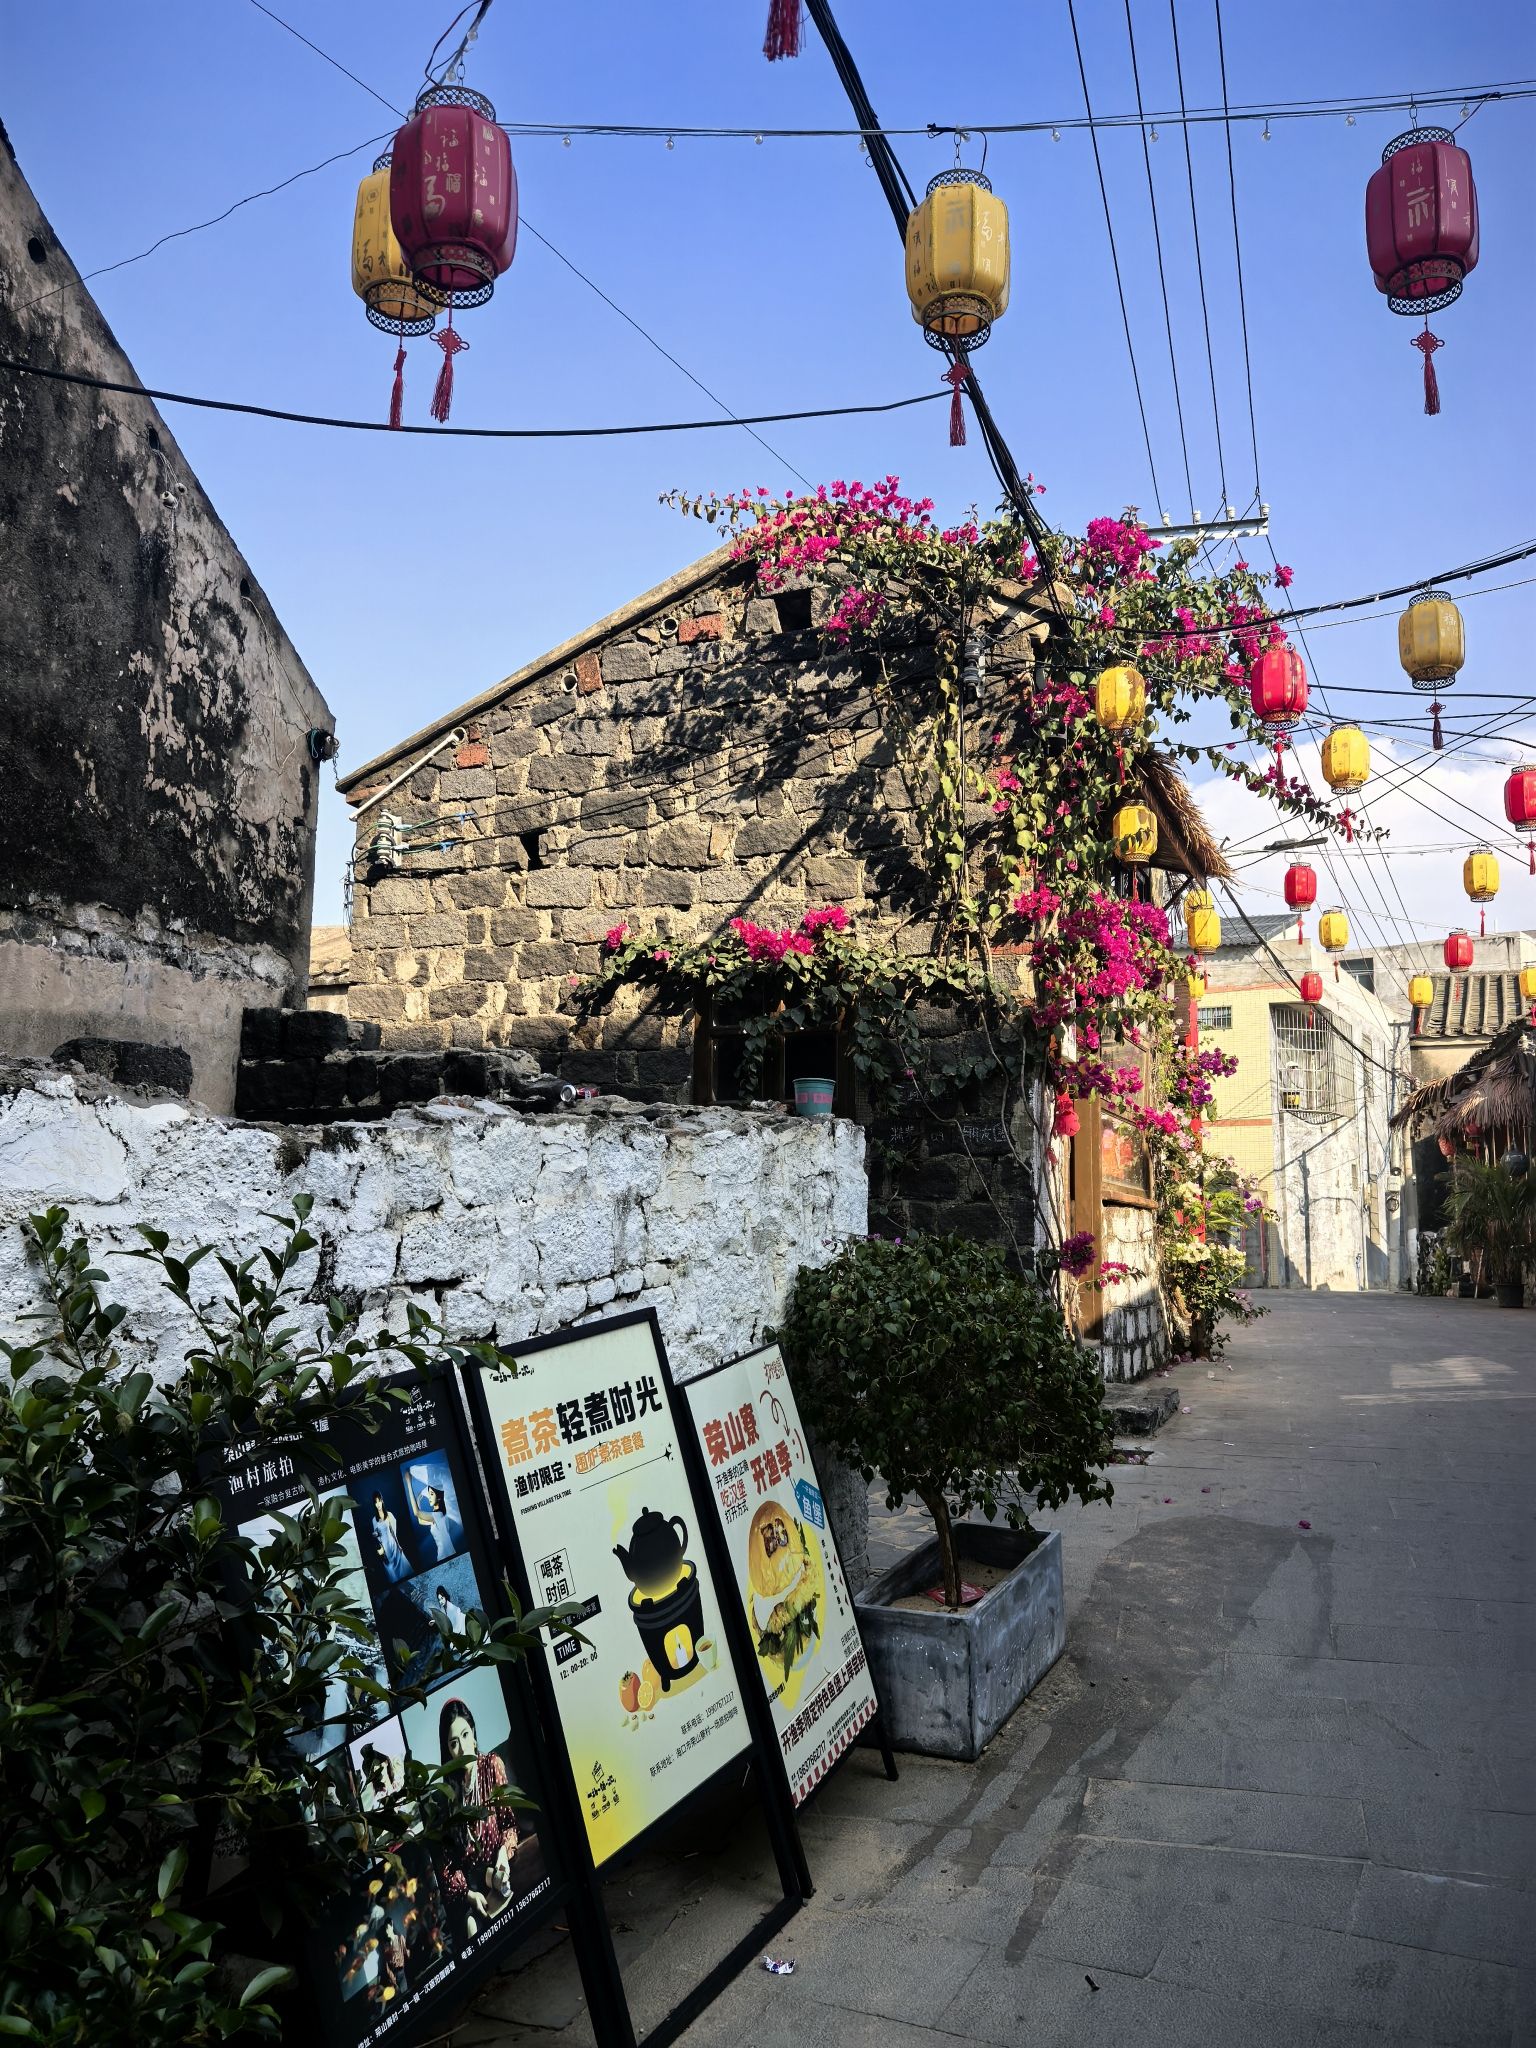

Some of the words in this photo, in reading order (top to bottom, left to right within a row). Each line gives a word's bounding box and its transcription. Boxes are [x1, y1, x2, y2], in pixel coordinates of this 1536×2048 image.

[500, 1375, 663, 1467] 煮茶轻煮时光
[702, 1403, 760, 1467] 荣山寮
[228, 1455, 295, 1496] 渔村旅拍
[749, 1439, 793, 1496] 开渔季
[540, 1555, 565, 1580] 喝茶
[545, 1578, 570, 1603] 时间
[556, 1639, 578, 1659] TIME
